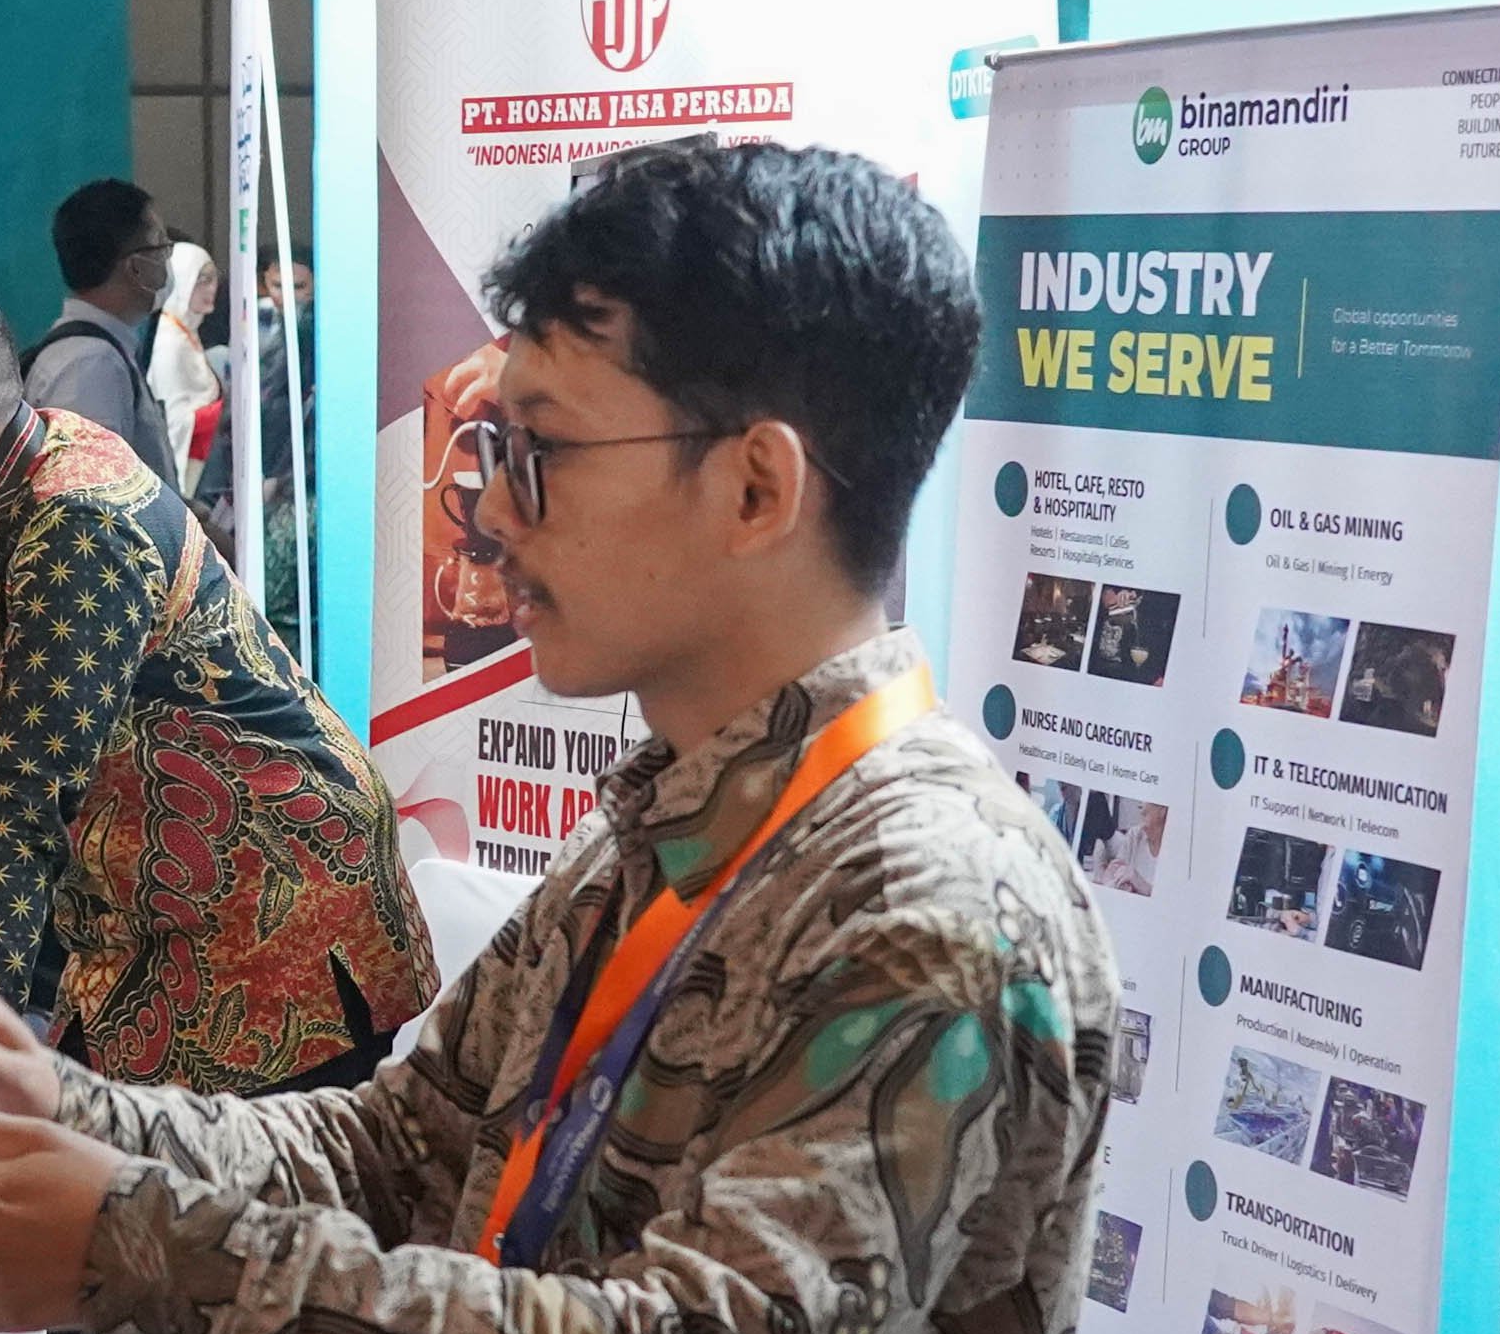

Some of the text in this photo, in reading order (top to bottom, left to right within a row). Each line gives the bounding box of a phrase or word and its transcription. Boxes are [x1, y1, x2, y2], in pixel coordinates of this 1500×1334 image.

[462, 85, 792, 127] PT. HOSANA JASA PERSADA
[1180, 83, 1350, 130] binamandiri
[1178, 136, 1231, 156] GROUP
[1019, 250, 1274, 317] INDUSTRY
[1332, 307, 1459, 329] Global opportunities
[1016, 326, 1275, 402] WE SERVE
[1348, 341, 1358, 355] a
[1358, 338, 1400, 356] Better
[1034, 469, 1145, 500] HOTEL, CAFE, RESTO
[1033, 495, 1117, 523] & HOSPITALITY
[1269, 507, 1404, 542] OIL & GAS MINING
[1265, 553, 1281, 568] Oil
[1291, 557, 1310, 573] Gas
[1357, 565, 1394, 587] Energy
[477, 717, 620, 777] EXPAND YOUR
[1021, 707, 1153, 754] NURSE AND CAREGIVER
[1018, 742, 1058, 762] Healthcare
[1112, 764, 1138, 781] Home
[1138, 770, 1161, 786] Care
[1253, 754, 1449, 815] IT & TELECOMMUNICATION
[477, 773, 552, 841] WORK
[1250, 794, 1400, 840] IT Support Network Telecom
[1239, 973, 1364, 1028] MANUFACTURING
[1236, 1013, 1402, 1076] Production Assembly Operation
[1224, 1190, 1356, 1258] TRANSPORTATION
[1220, 1229, 1379, 1304] Truck Driver Logistics Delivery
